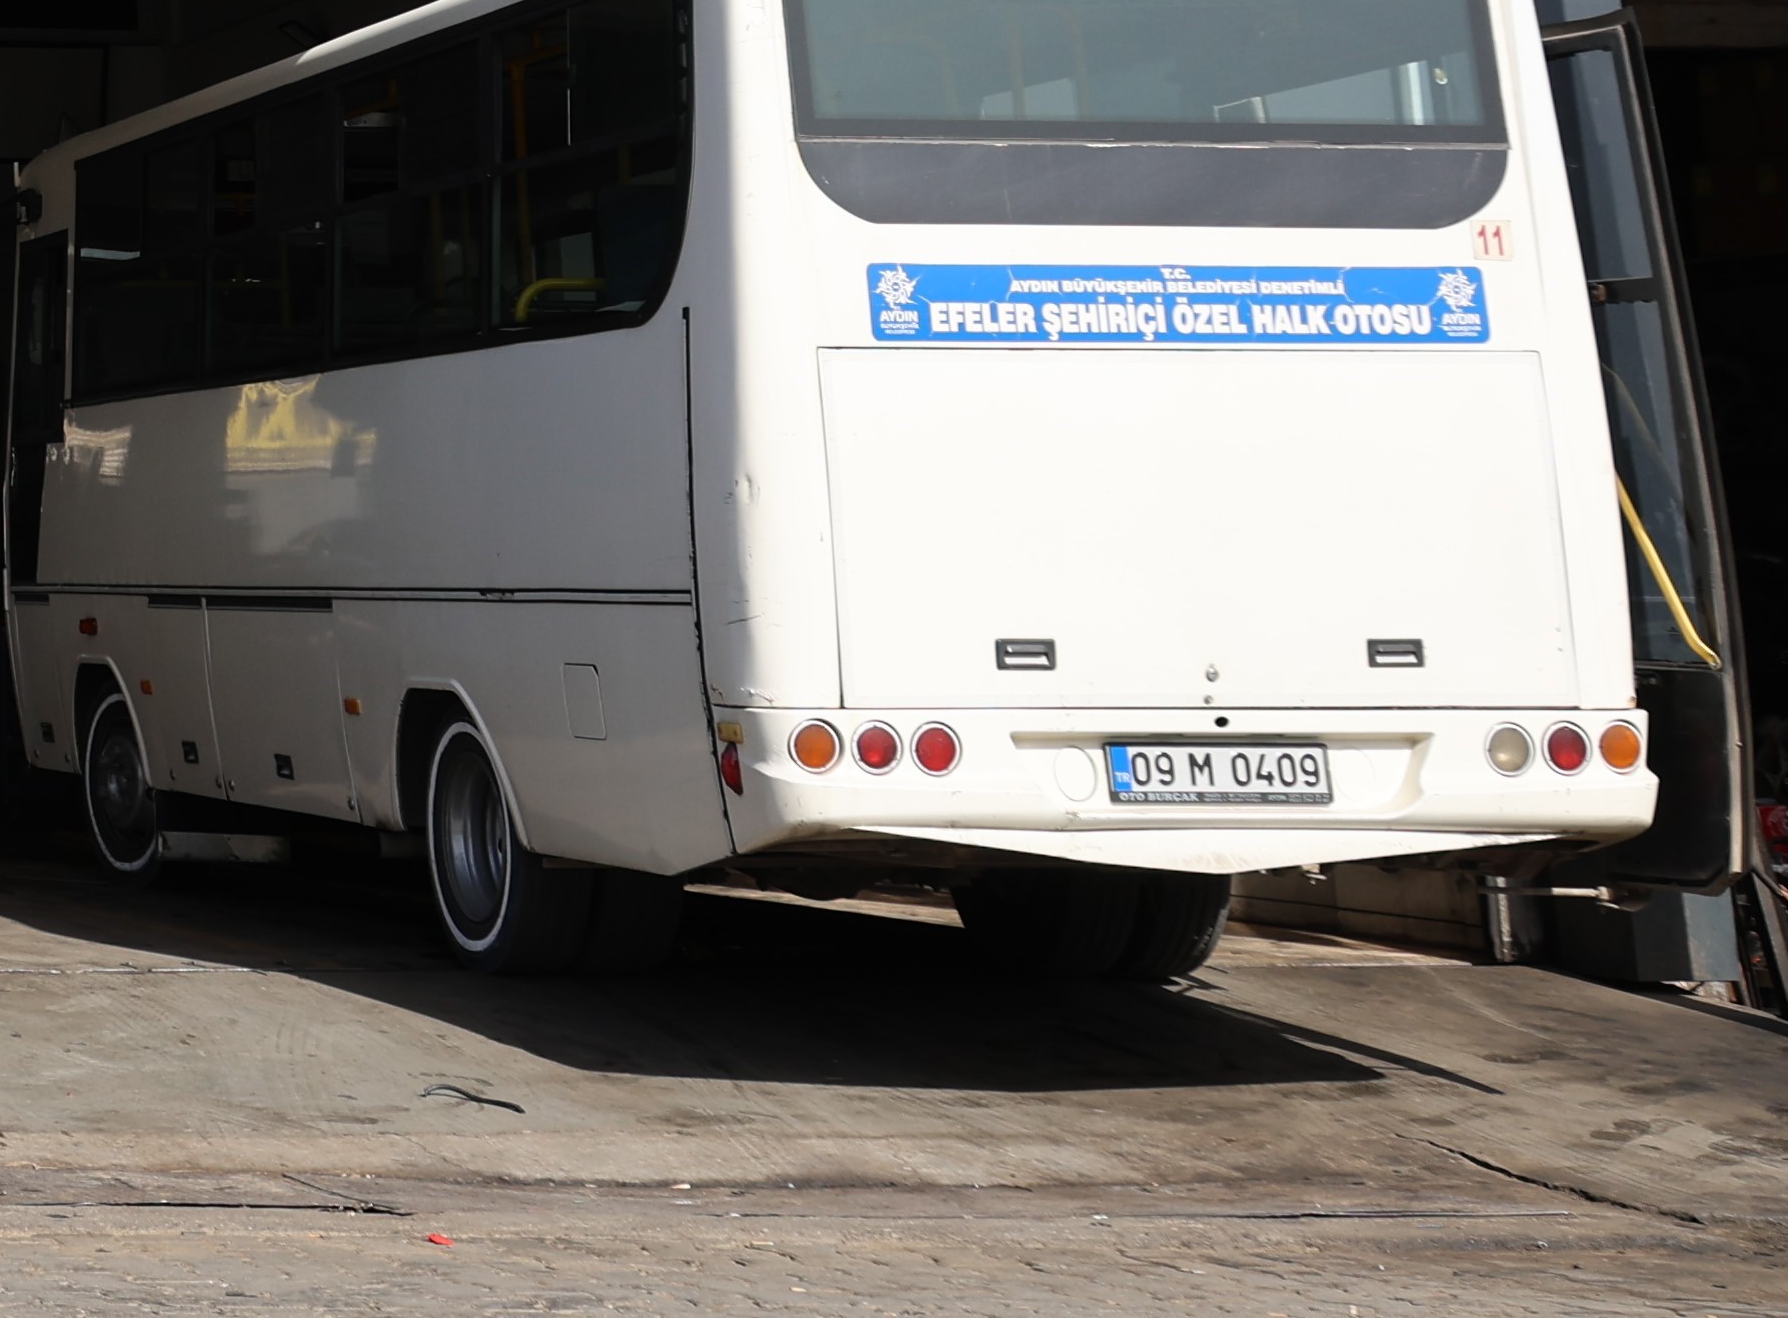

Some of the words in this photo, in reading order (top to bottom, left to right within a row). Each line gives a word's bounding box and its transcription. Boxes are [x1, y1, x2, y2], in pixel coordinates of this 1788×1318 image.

[1477, 224, 1505, 257] 11
[1010, 280, 1060, 293] AYDIN
[1061, 278, 1164, 296] BÜYÜKŞEHİR
[1166, 279, 1258, 295] BELEDİYESİ
[1260, 280, 1346, 295] DENETİMLİ
[880, 310, 919, 323] AYDIN
[928, 302, 1039, 334] EFELER
[1041, 296, 1167, 341] ŞEHİRİÇİ
[1172, 297, 1249, 334] ÖZEL
[1251, 303, 1332, 334] HALK
[1333, 302, 1433, 335] OTOSU
[1131, 751, 1176, 787] 09
[1187, 752, 1215, 787] M
[1230, 752, 1321, 788] 0409
